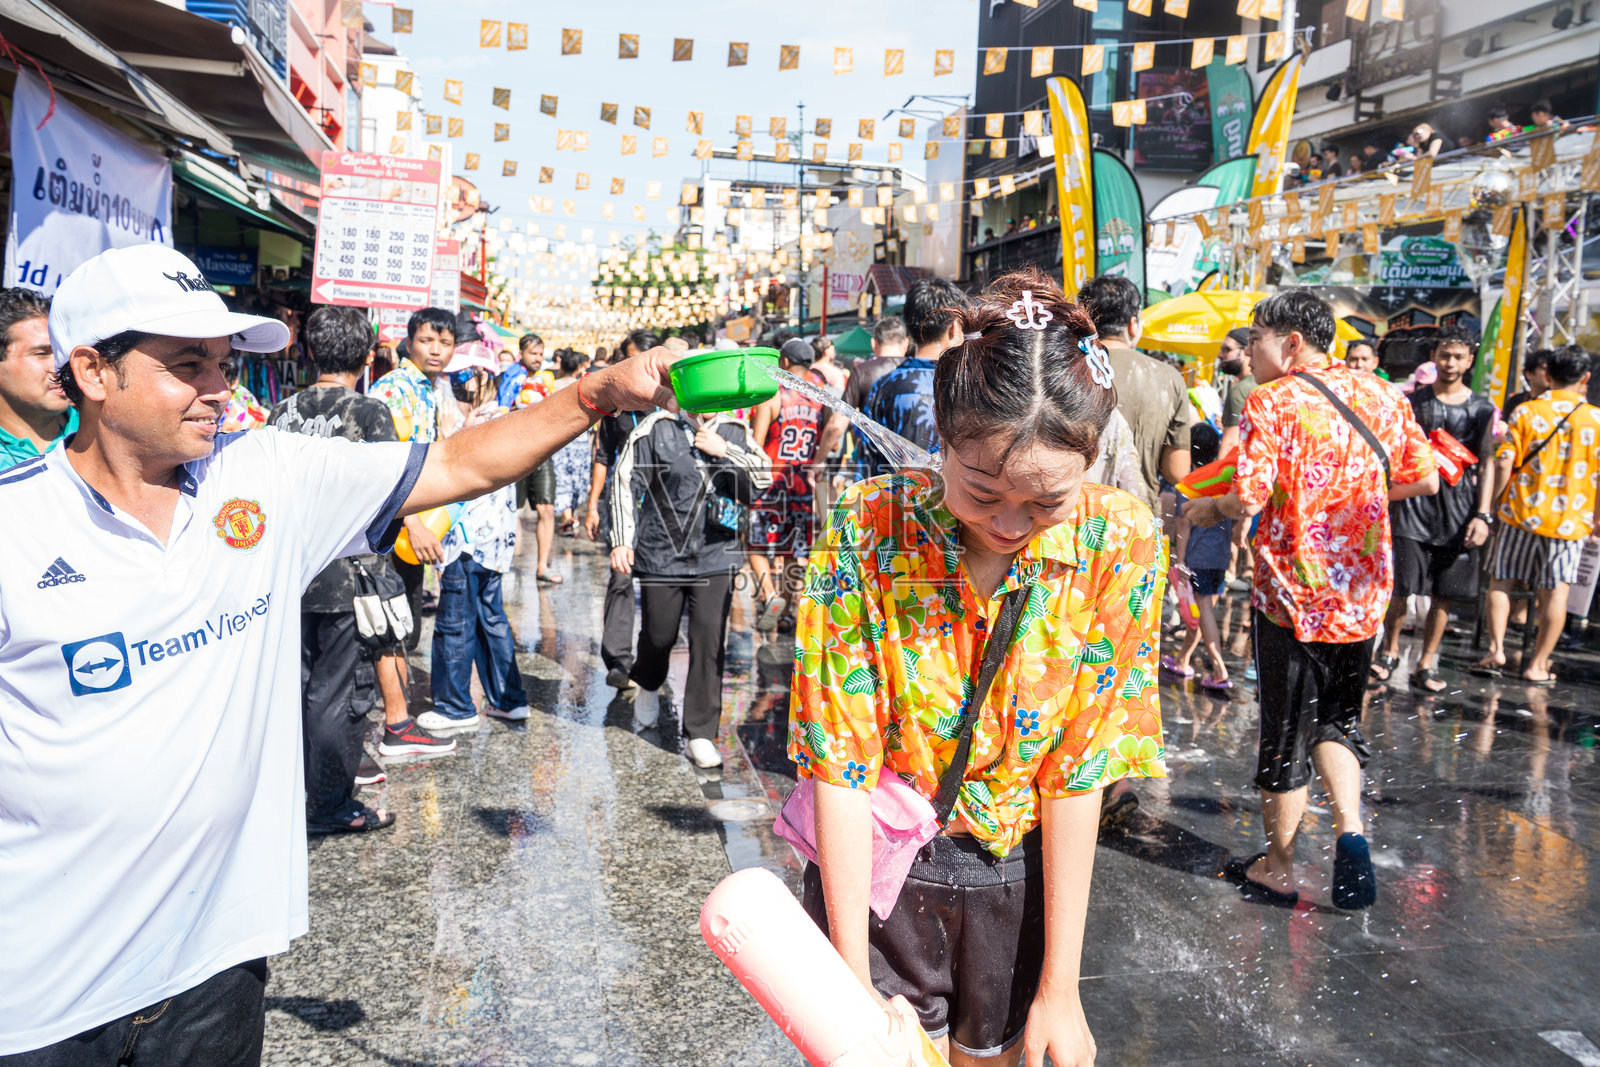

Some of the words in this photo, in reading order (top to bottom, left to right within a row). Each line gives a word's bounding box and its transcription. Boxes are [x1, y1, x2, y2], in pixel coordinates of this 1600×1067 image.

[353, 166, 384, 177] Massage
[394, 169, 408, 179] Spa
[342, 227, 357, 237] 180
[366, 229, 380, 239] 180
[389, 231, 405, 241] 250
[413, 233, 429, 243] 200
[340, 241, 356, 250] 300
[364, 243, 379, 253] 300
[388, 245, 403, 255] 400
[412, 248, 428, 257] 350
[1411, 242, 1450, 260] Chang
[197, 257, 253, 275] Massage
[340, 255, 355, 264] 450
[363, 257, 378, 266] 450
[387, 259, 402, 269] 550
[411, 261, 426, 271] 550
[338, 268, 353, 278] 600
[362, 270, 377, 280] 600
[386, 272, 401, 282] 700
[410, 275, 425, 285] 700
[1166, 323, 1209, 334] SINGHA
[777, 425, 818, 461] 23
[234, 531, 261, 547] UNITED
[37, 572, 86, 589] adidas
